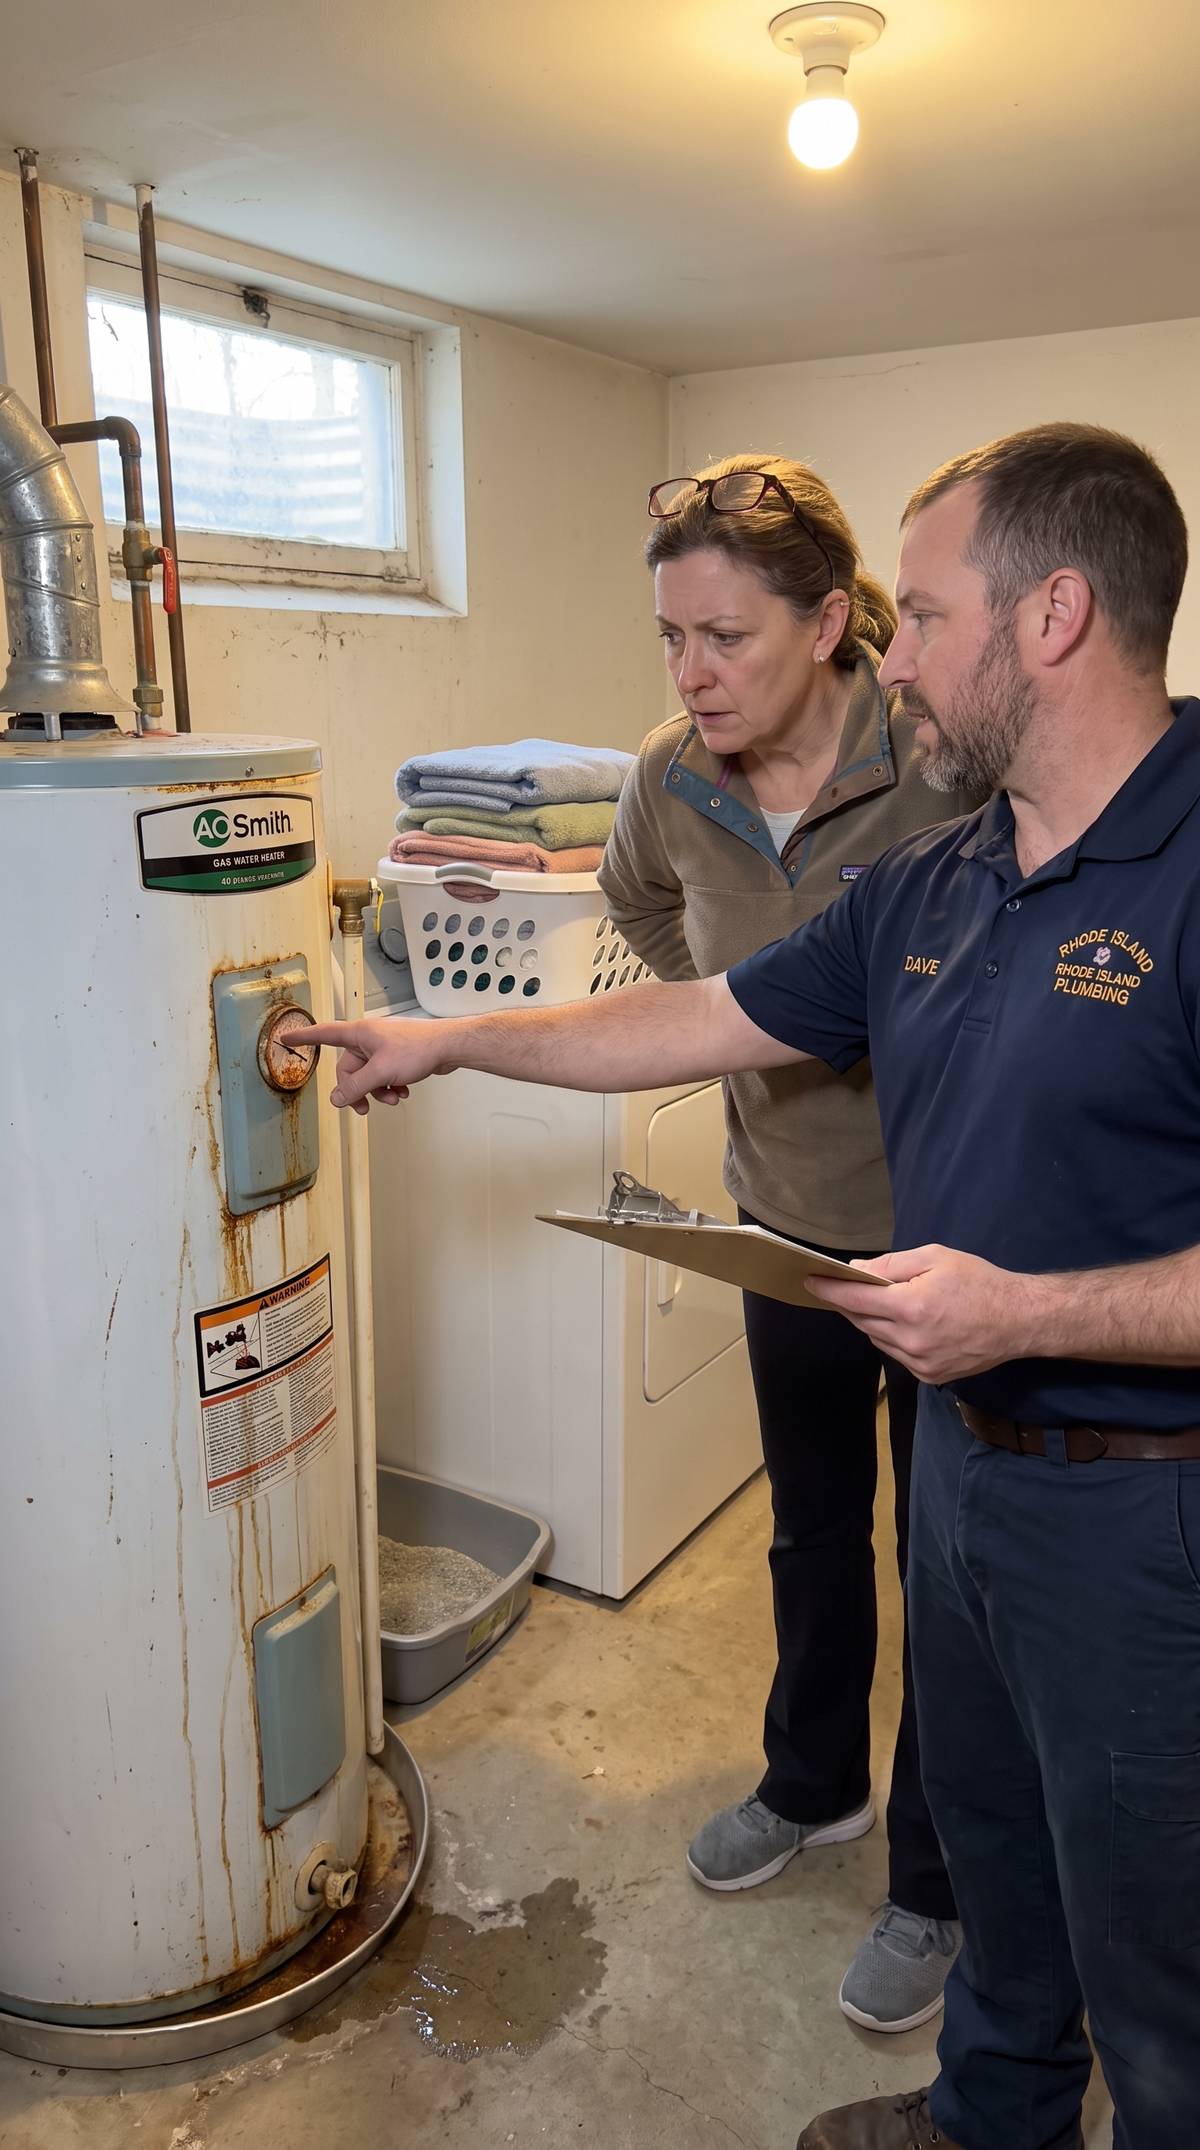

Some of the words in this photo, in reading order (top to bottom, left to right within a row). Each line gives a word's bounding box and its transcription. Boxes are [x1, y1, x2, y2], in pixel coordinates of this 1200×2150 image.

[233, 810, 291, 838] Smith
[213, 857, 232, 868] GAS
[233, 854, 260, 866] WATER
[260, 851, 285, 862] HEATER
[221, 877, 231, 885] 40
[1058, 928, 1109, 958] RHODE
[1109, 929, 1154, 973] ISLAND
[904, 955, 941, 975] DAVE
[1055, 962, 1096, 979] RHODE
[1095, 968, 1141, 989] ISLAND
[1053, 977, 1130, 1006] PLUMBING
[269, 1276, 310, 1306] WARNING
